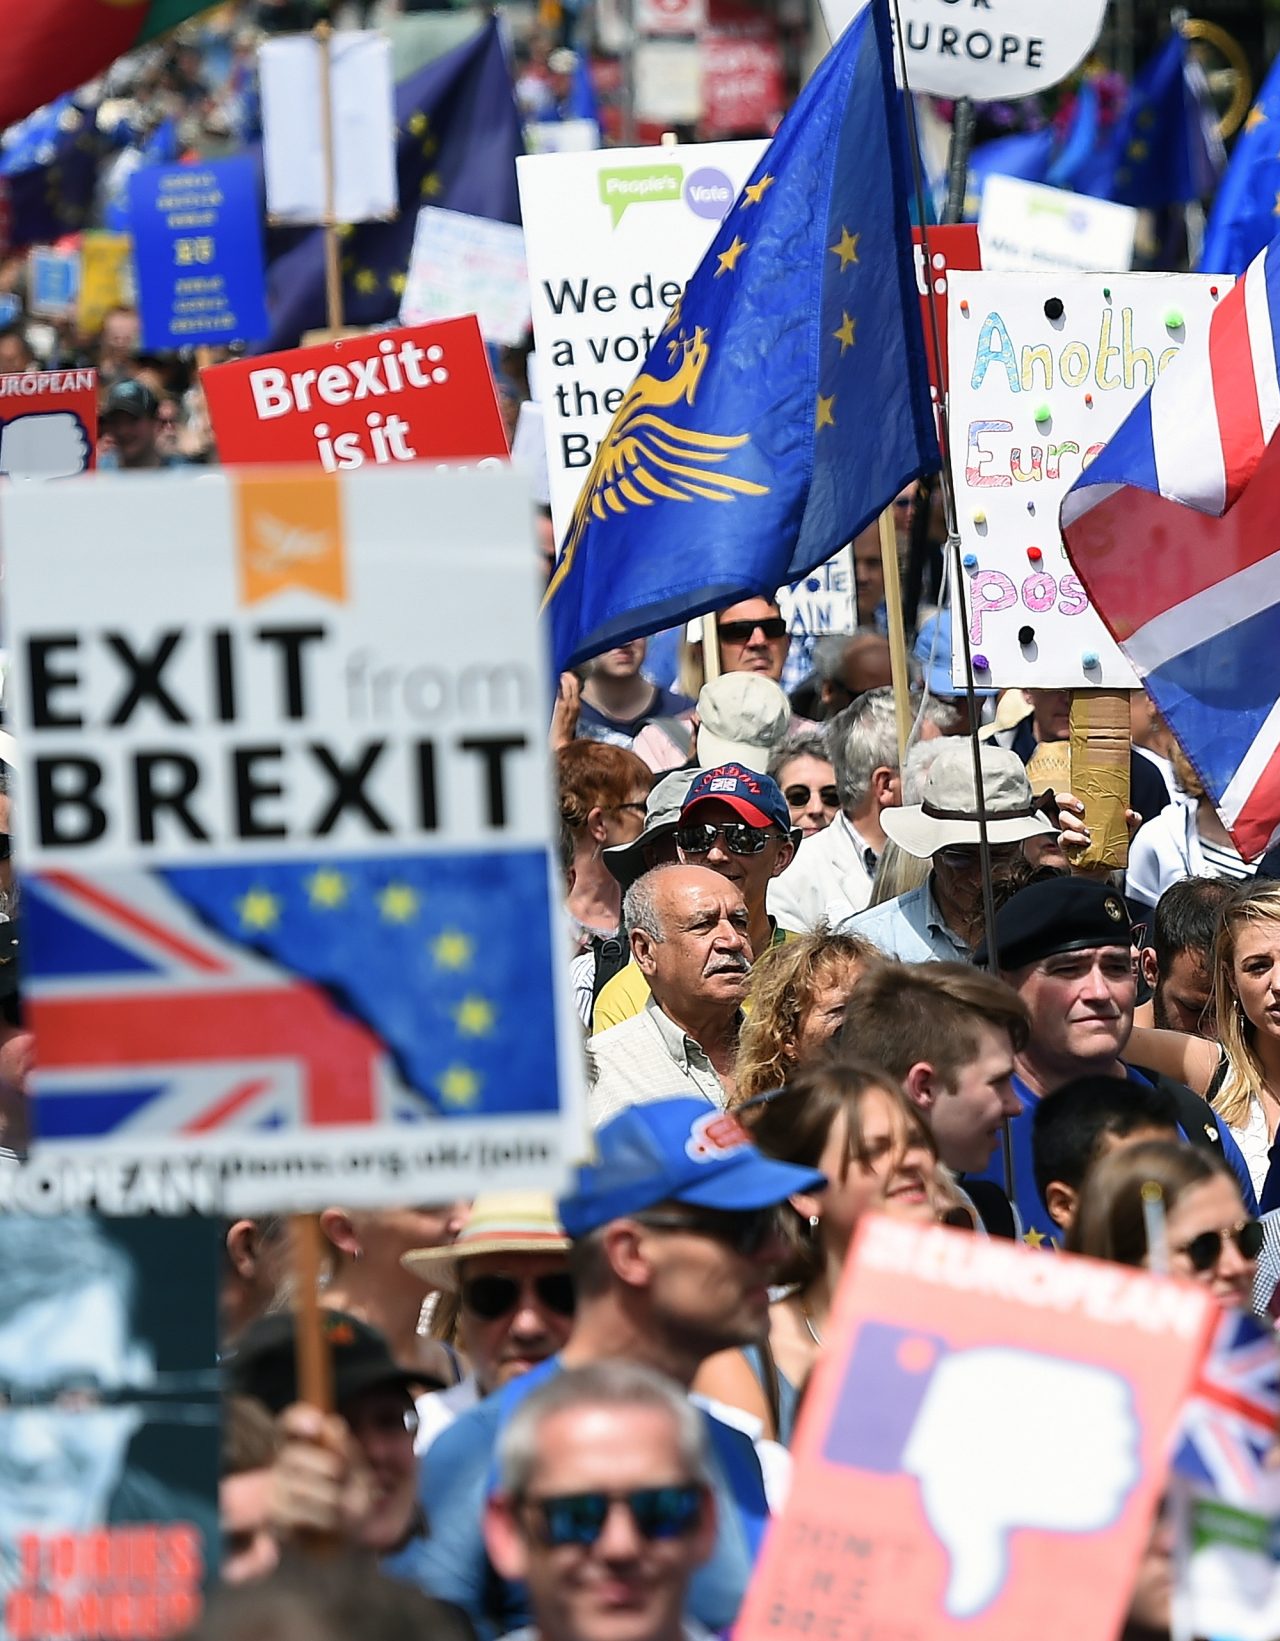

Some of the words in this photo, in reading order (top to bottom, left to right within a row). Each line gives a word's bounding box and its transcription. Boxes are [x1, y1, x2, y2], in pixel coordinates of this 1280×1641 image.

[891, 19, 1043, 68] UROPE
[606, 174, 679, 194] People's
[689, 184, 730, 202] Vote
[543, 278, 617, 315] We
[630, 274, 682, 310] de
[551, 340, 575, 366] a
[587, 327, 656, 364] vot
[249, 339, 449, 420] Brexit:
[554, 381, 626, 418] the
[313, 422, 365, 473] is
[366, 411, 416, 464] it
[969, 570, 1089, 645] pos
[25, 624, 326, 730] EXIT
[342, 648, 533, 723] from
[33, 734, 529, 849] BREXIT
[694, 766, 761, 793] LONDON
